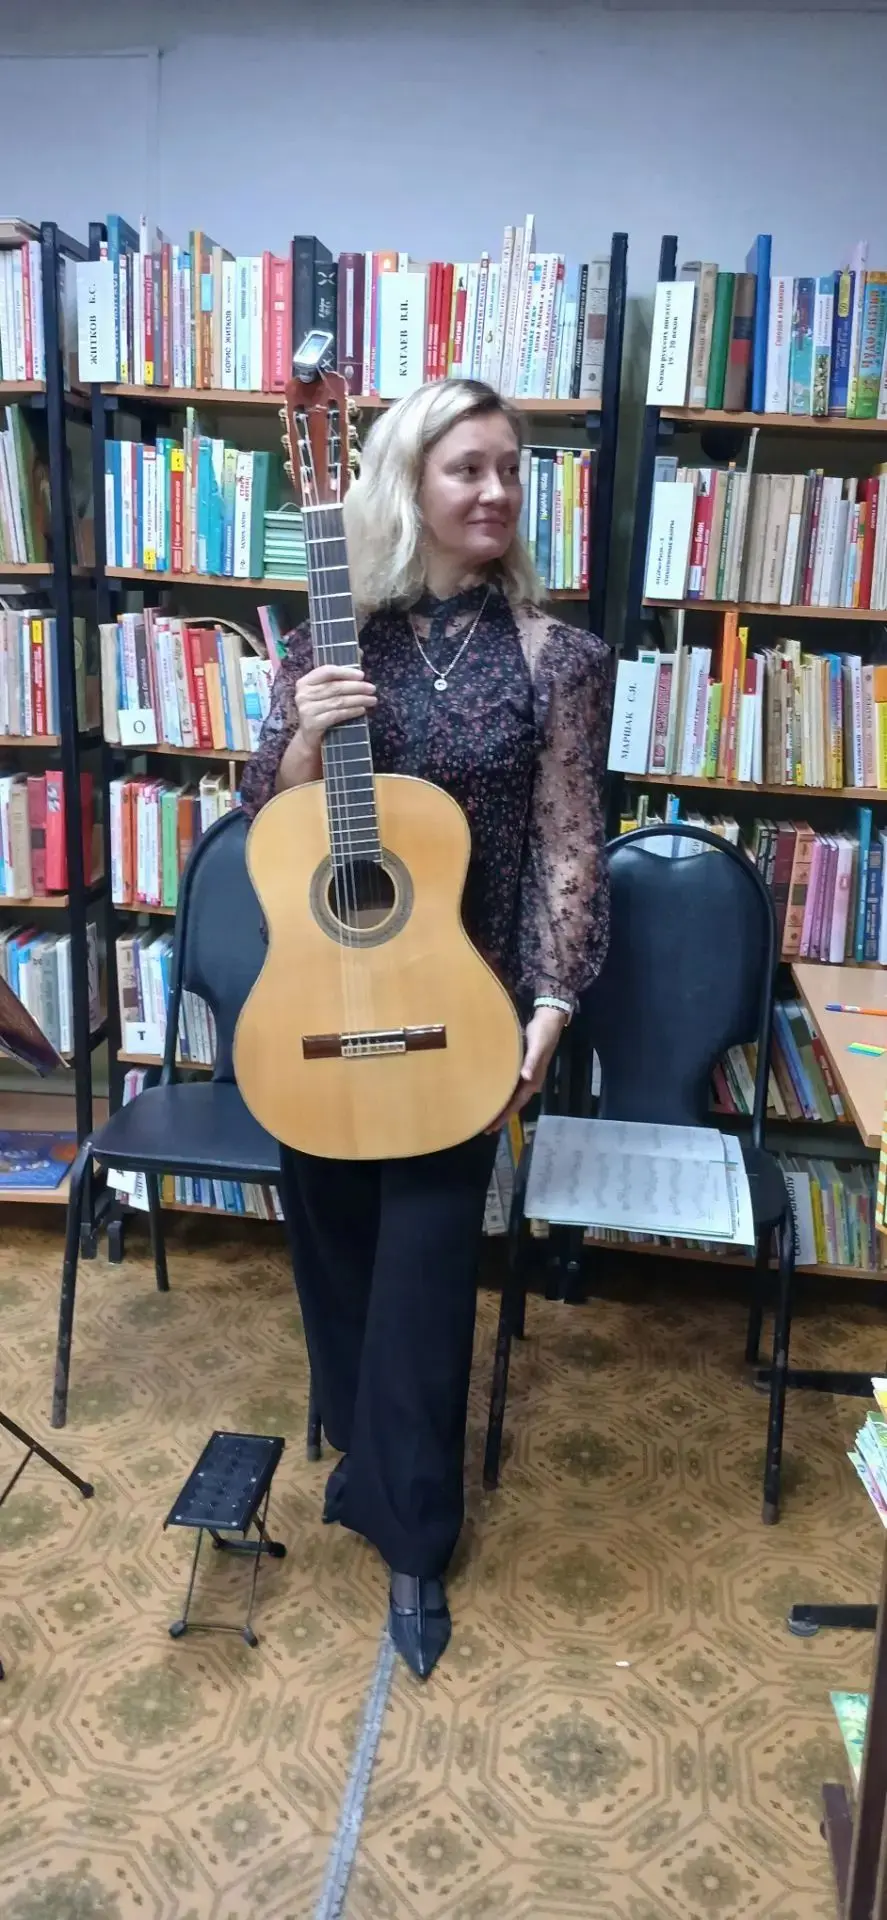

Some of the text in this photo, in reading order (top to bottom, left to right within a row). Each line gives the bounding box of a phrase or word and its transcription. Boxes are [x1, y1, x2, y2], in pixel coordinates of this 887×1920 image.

[88, 283, 98, 365] ЖИТКОВ Б.С.
[224, 310, 232, 344] ЖИТКОВ
[399, 330, 408, 377] КАТАЕВ
[656, 363, 665, 392] Сказки
[661, 331, 669, 362] русских
[667, 357, 674, 365] 19
[670, 340, 676, 349] 20
[695, 521, 705, 543] Блок
[620, 682, 637, 760] МАРШАК С.Я.
[137, 1030, 146, 1041] Т
[786, 1176, 798, 1212] ШКОЛУ
